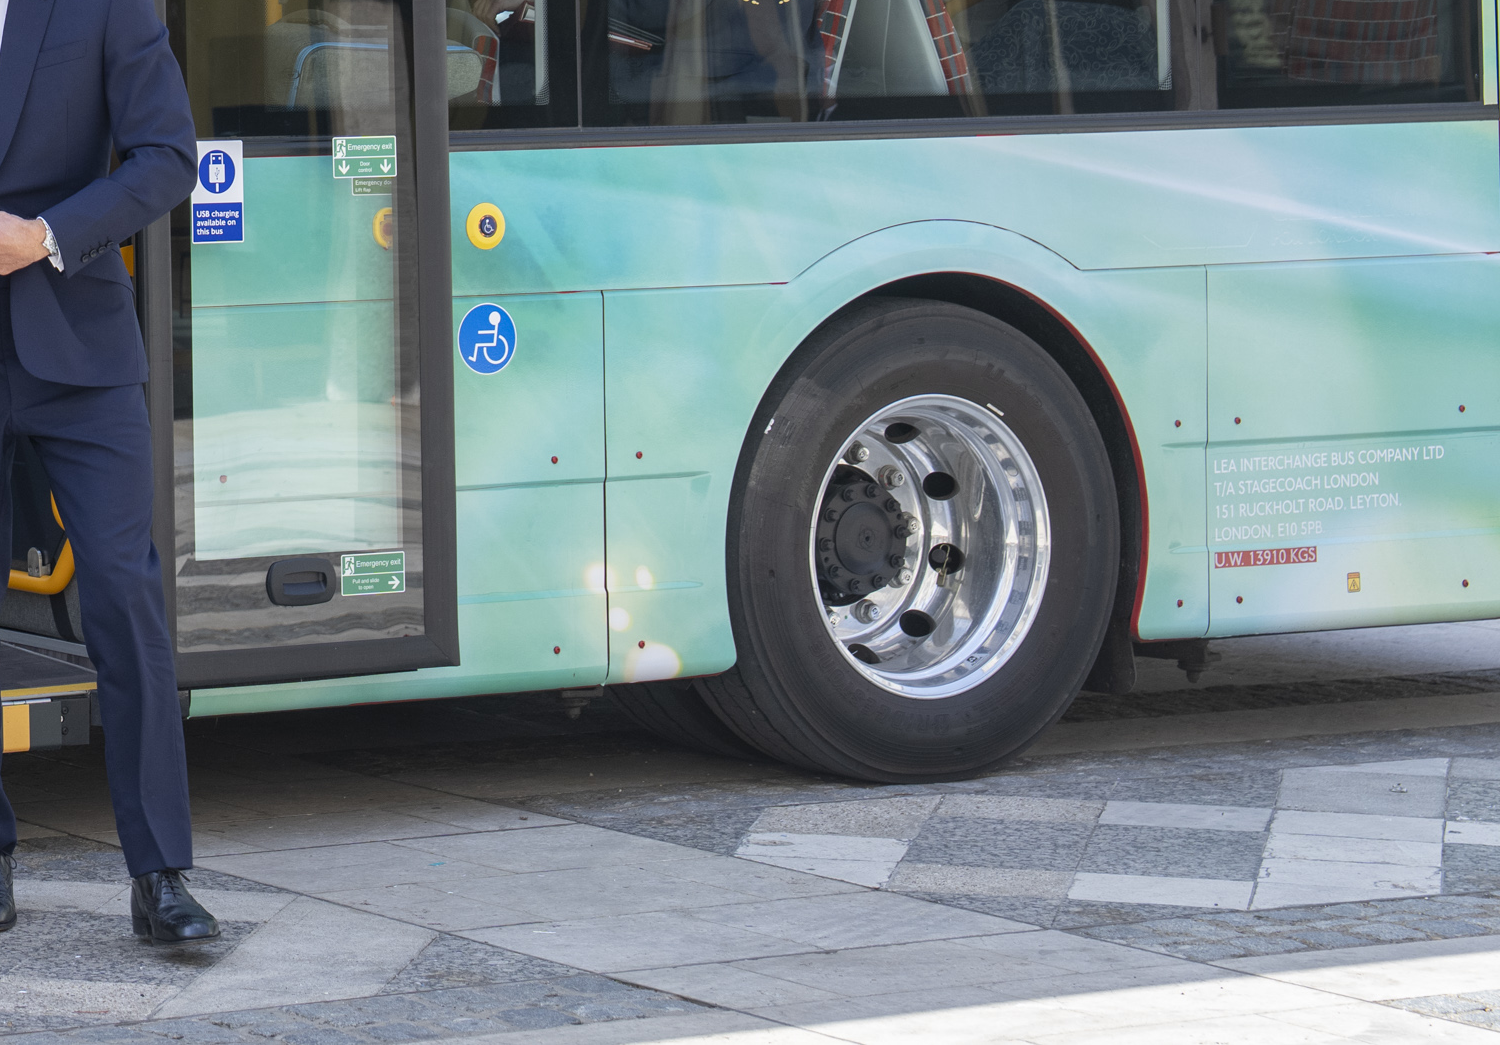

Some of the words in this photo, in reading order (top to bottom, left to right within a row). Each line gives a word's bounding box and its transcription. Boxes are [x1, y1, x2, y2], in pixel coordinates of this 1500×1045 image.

[347, 143, 381, 152] Emergency
[196, 210, 211, 218] USB
[211, 210, 240, 218] charging
[196, 219, 226, 227] available
[196, 227, 210, 235] this
[210, 227, 224, 235] bus
[1213, 459, 1237, 474] LEA
[1240, 453, 1328, 472] INTERCHANGE
[1331, 451, 1355, 467] BUS
[1358, 446, 1420, 464] COMPANY
[1423, 445, 1445, 460] LTD
[1214, 481, 1236, 497] T/A
[1238, 475, 1321, 495] STAGECOACH
[1324, 472, 1379, 489] LONDON
[1215, 504, 1235, 519] 151
[1239, 499, 1306, 517] RUCKHOLT
[1277, 522, 1298, 537] E10
[356, 559, 389, 569] Emergency
[390, 558, 401, 566] exit
[1215, 552, 1245, 568] U.W.
[1249, 549, 1287, 566] 13910
[1290, 546, 1316, 562] KGS
